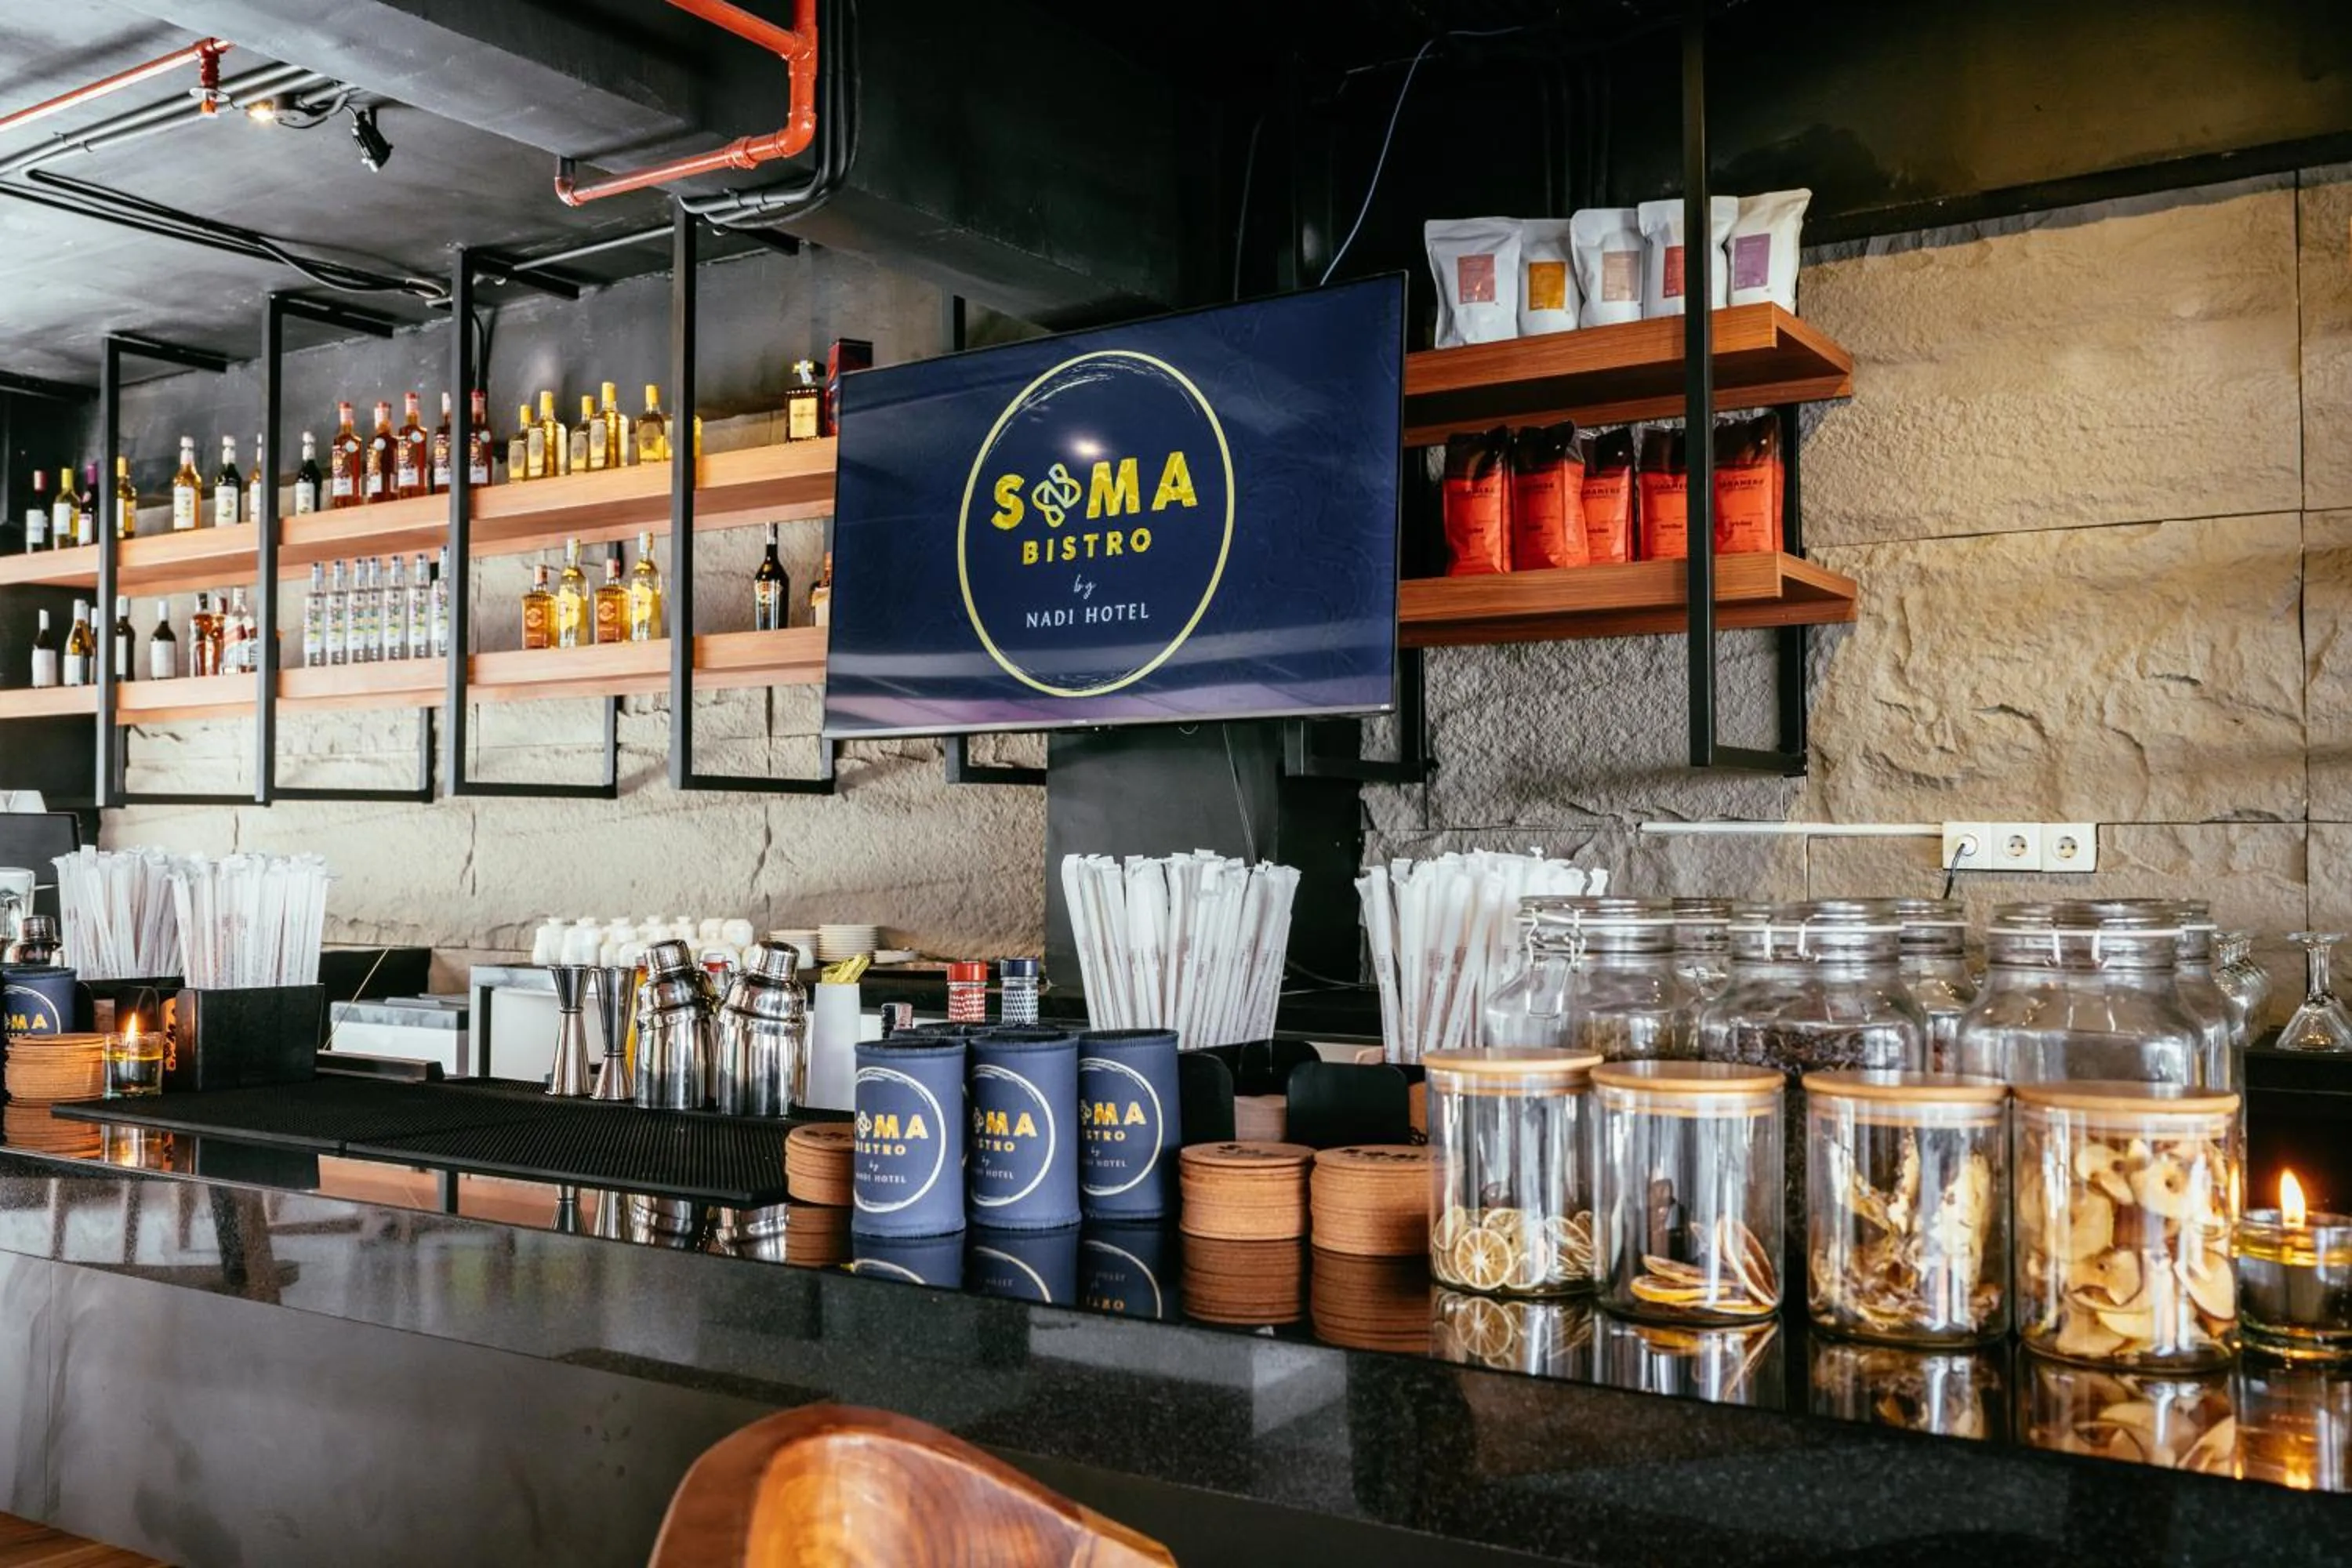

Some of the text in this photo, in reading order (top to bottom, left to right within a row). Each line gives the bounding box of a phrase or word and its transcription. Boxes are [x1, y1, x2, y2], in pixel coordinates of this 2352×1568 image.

[1022, 527, 1152, 565] BISTRO
[1073, 574, 1097, 600] by
[1026, 602, 1150, 628] NADI HOTEL
[977, 1138, 1015, 1153] STRO
[1086, 1130, 1126, 1142] STRO
[874, 1174, 907, 1184] HOTEL
